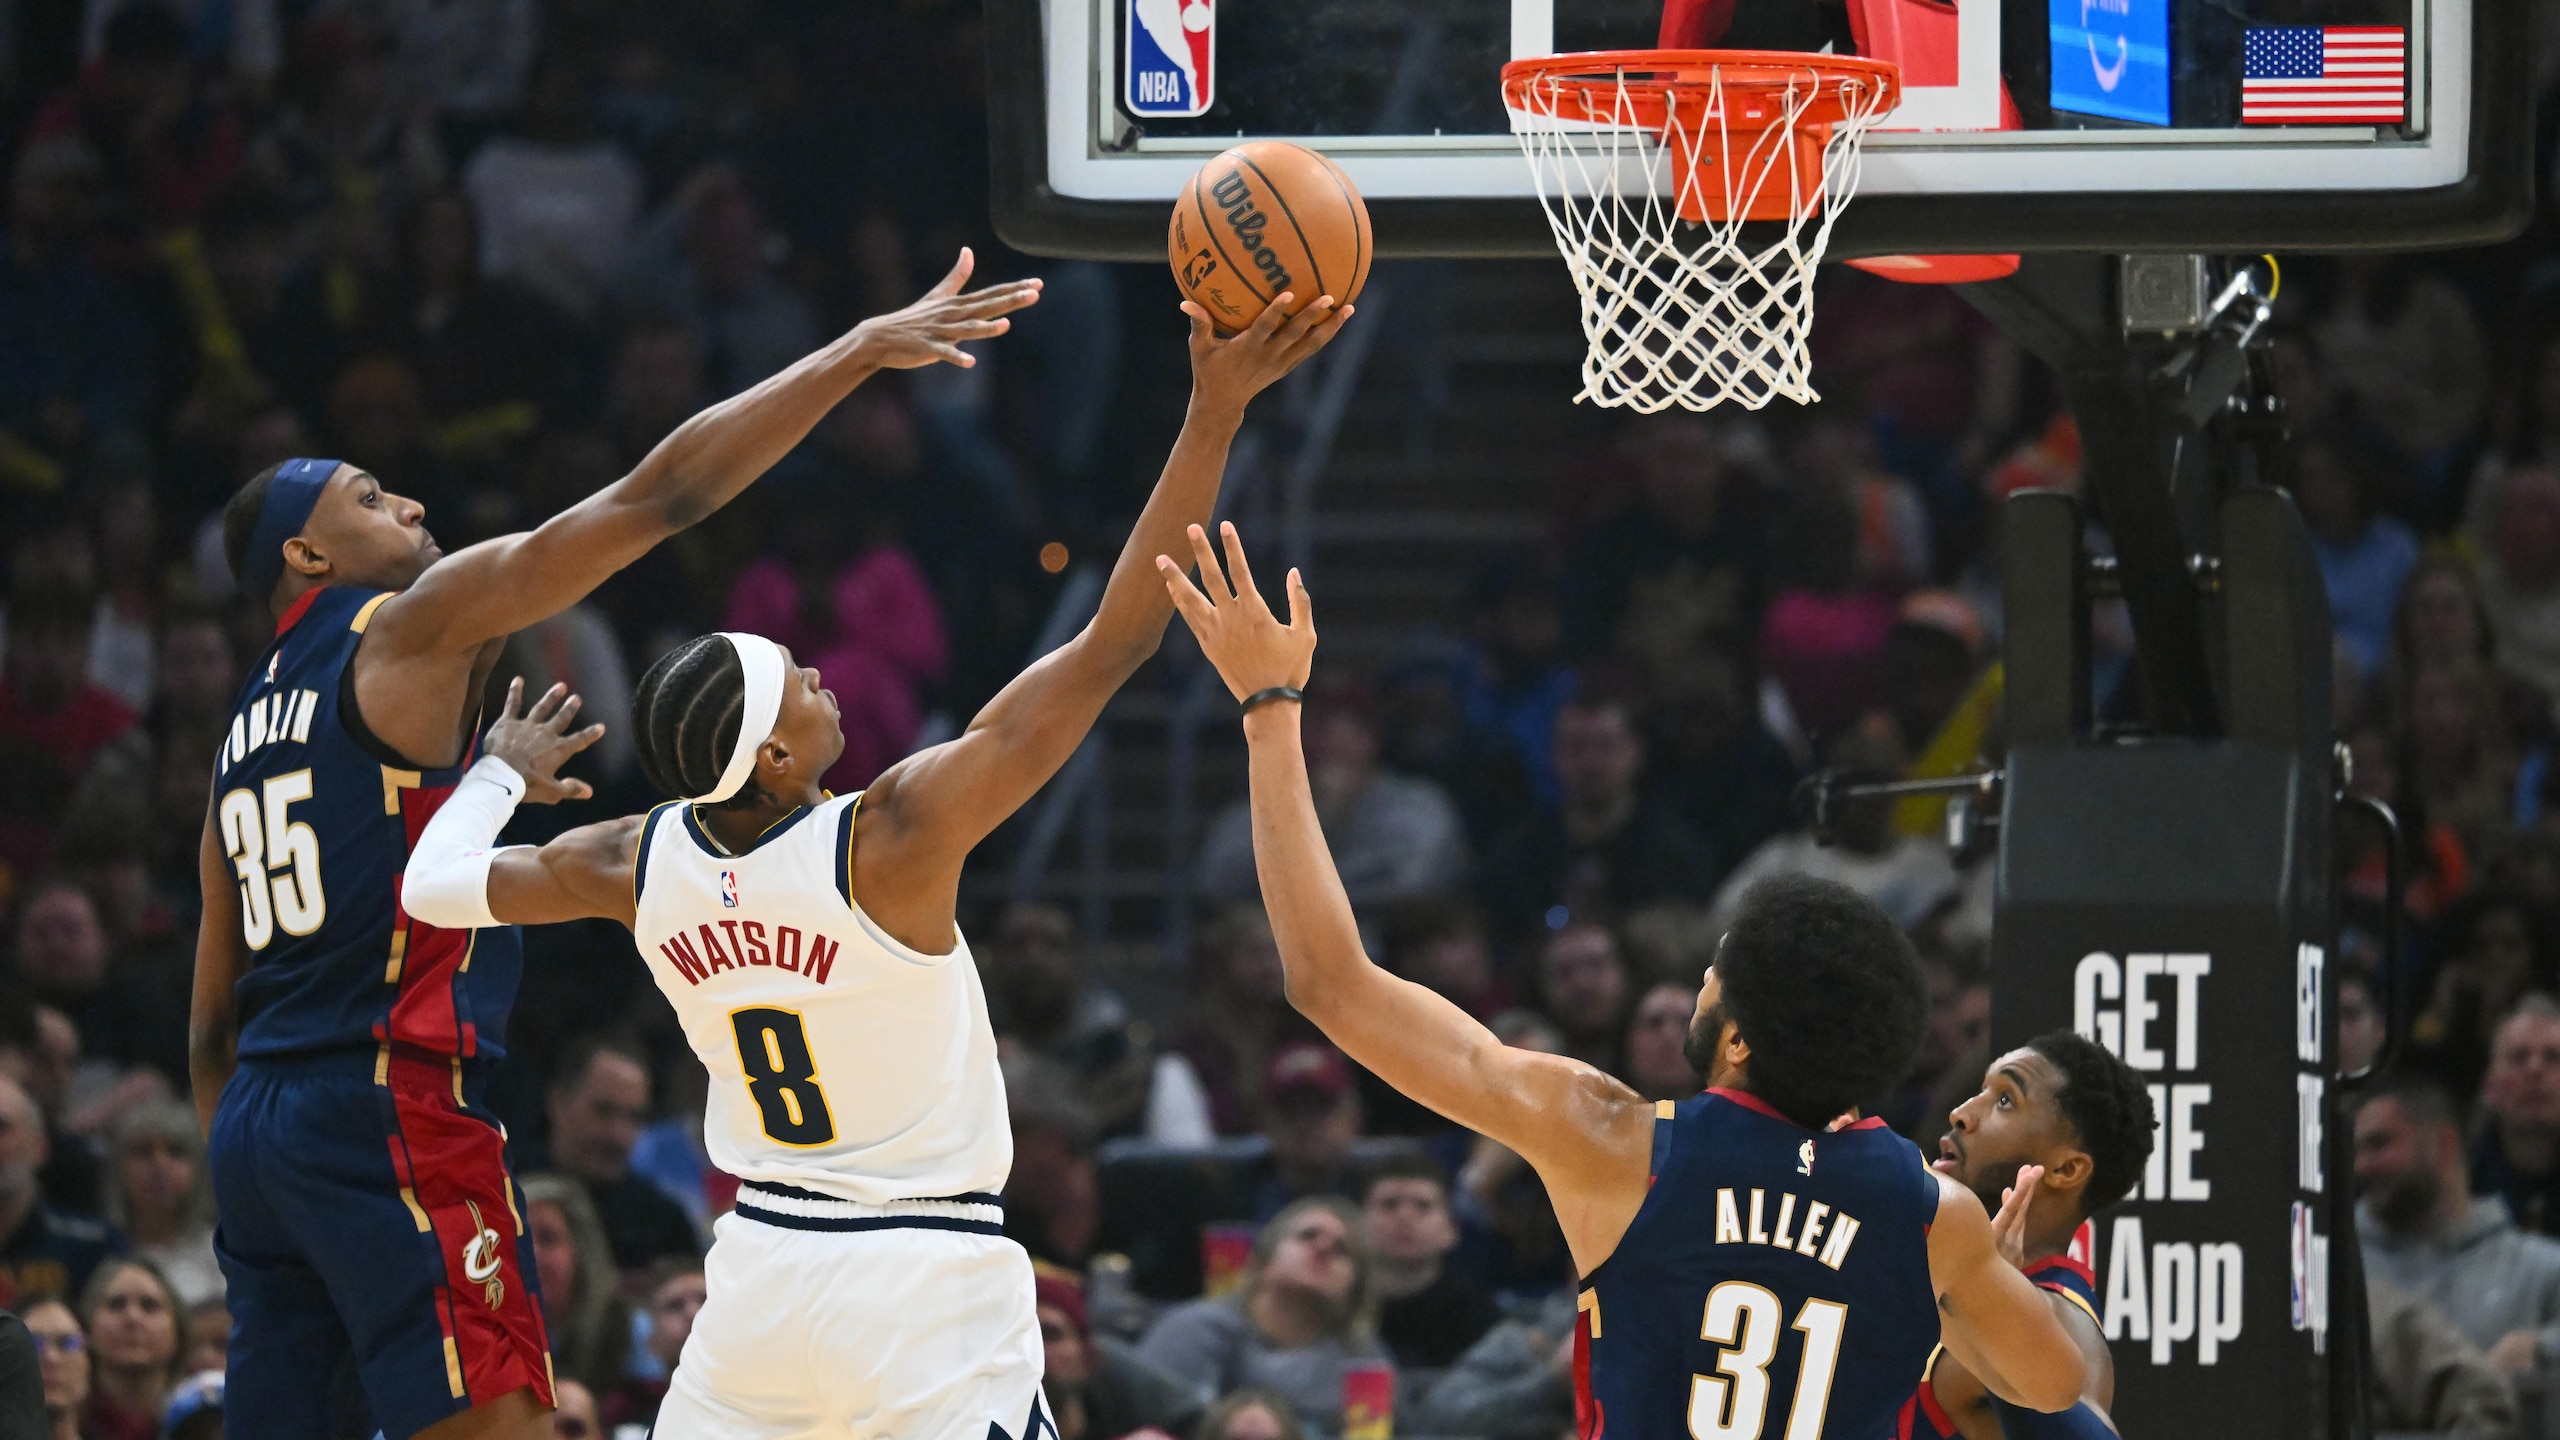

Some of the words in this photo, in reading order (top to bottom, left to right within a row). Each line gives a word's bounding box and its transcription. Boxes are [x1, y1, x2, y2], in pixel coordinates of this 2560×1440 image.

[1139, 71, 1179, 103] NBA
[1211, 169, 1293, 293] Wilson
[219, 767, 327, 951] 35
[659, 920, 839, 986] WATSON
[2074, 951, 2211, 1070] GET
[728, 1005, 838, 1149] 8
[1715, 1188, 1861, 1271] ALLEN
[2103, 1216, 2244, 1365] App
[1687, 1280, 1848, 1440] 31
